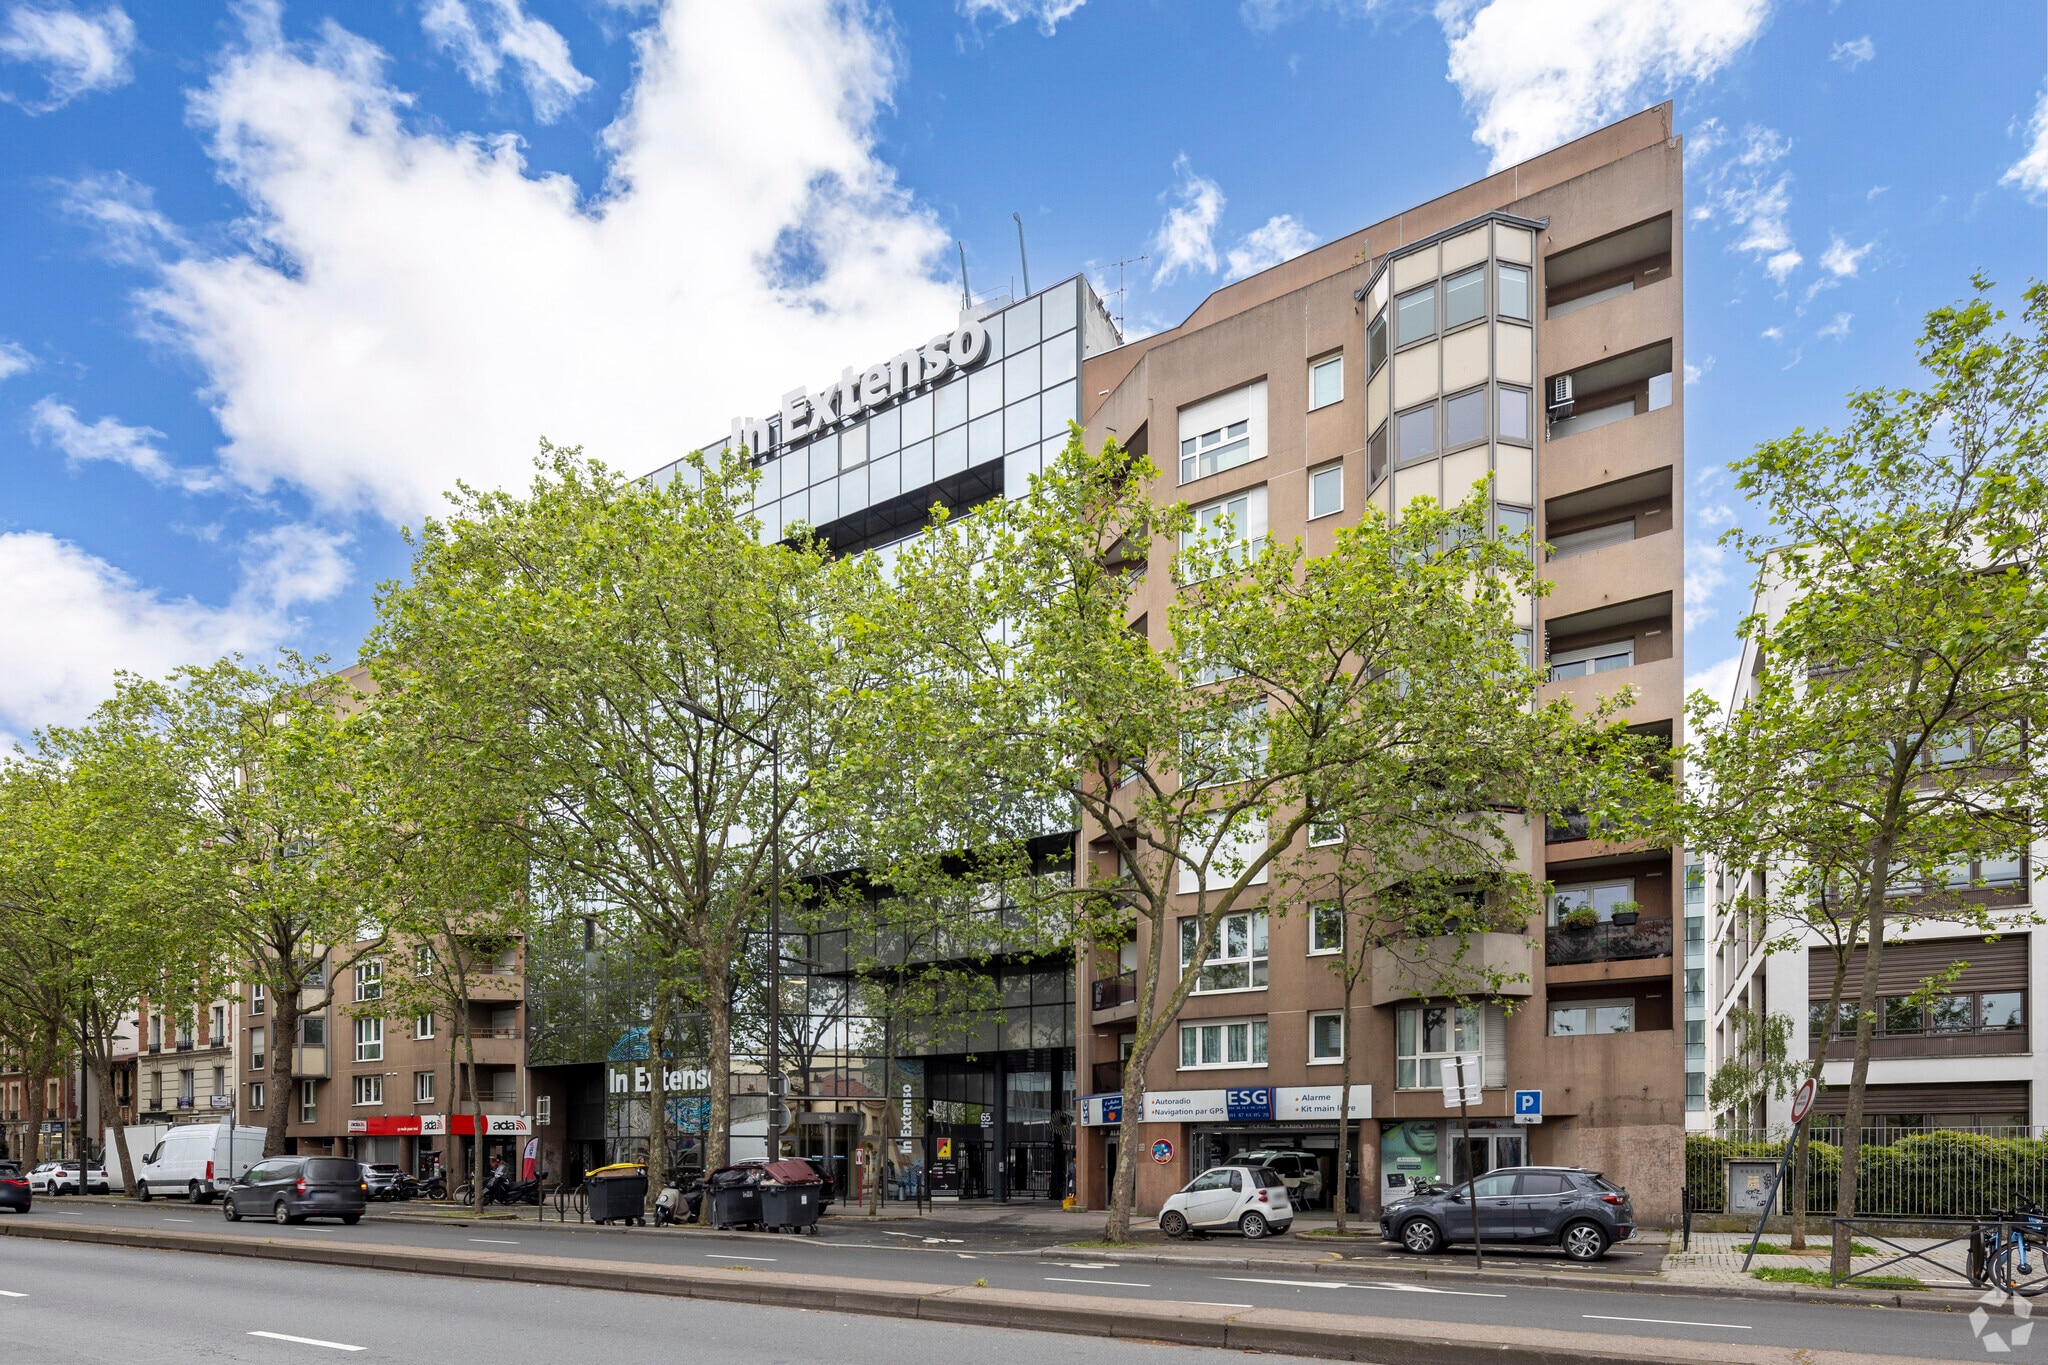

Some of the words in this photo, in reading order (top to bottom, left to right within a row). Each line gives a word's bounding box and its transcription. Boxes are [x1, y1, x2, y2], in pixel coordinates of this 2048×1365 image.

[731, 416, 769, 458] In
[782, 321, 987, 443] Extenso
[609, 1068, 628, 1093] In
[635, 1066, 711, 1092] Etens
[1155, 1097, 1191, 1105] Autoradio
[1228, 1090, 1268, 1105] ESG
[1301, 1094, 1331, 1102] Alarme
[1522, 1095, 1534, 1111] P
[901, 1084, 912, 1138] Extenso
[1154, 1107, 1193, 1117] Navigation
[1195, 1109, 1207, 1117] par
[1209, 1107, 1224, 1115] GPS
[1301, 1105, 1312, 1113] Kit
[1314, 1104, 1335, 1112] main
[1337, 1104, 1356, 1112] lire
[981, 1112, 991, 1122] 65
[425, 1119, 437, 1130] ada
[493, 1120, 515, 1130] ada
[901, 1140, 912, 1154] In
